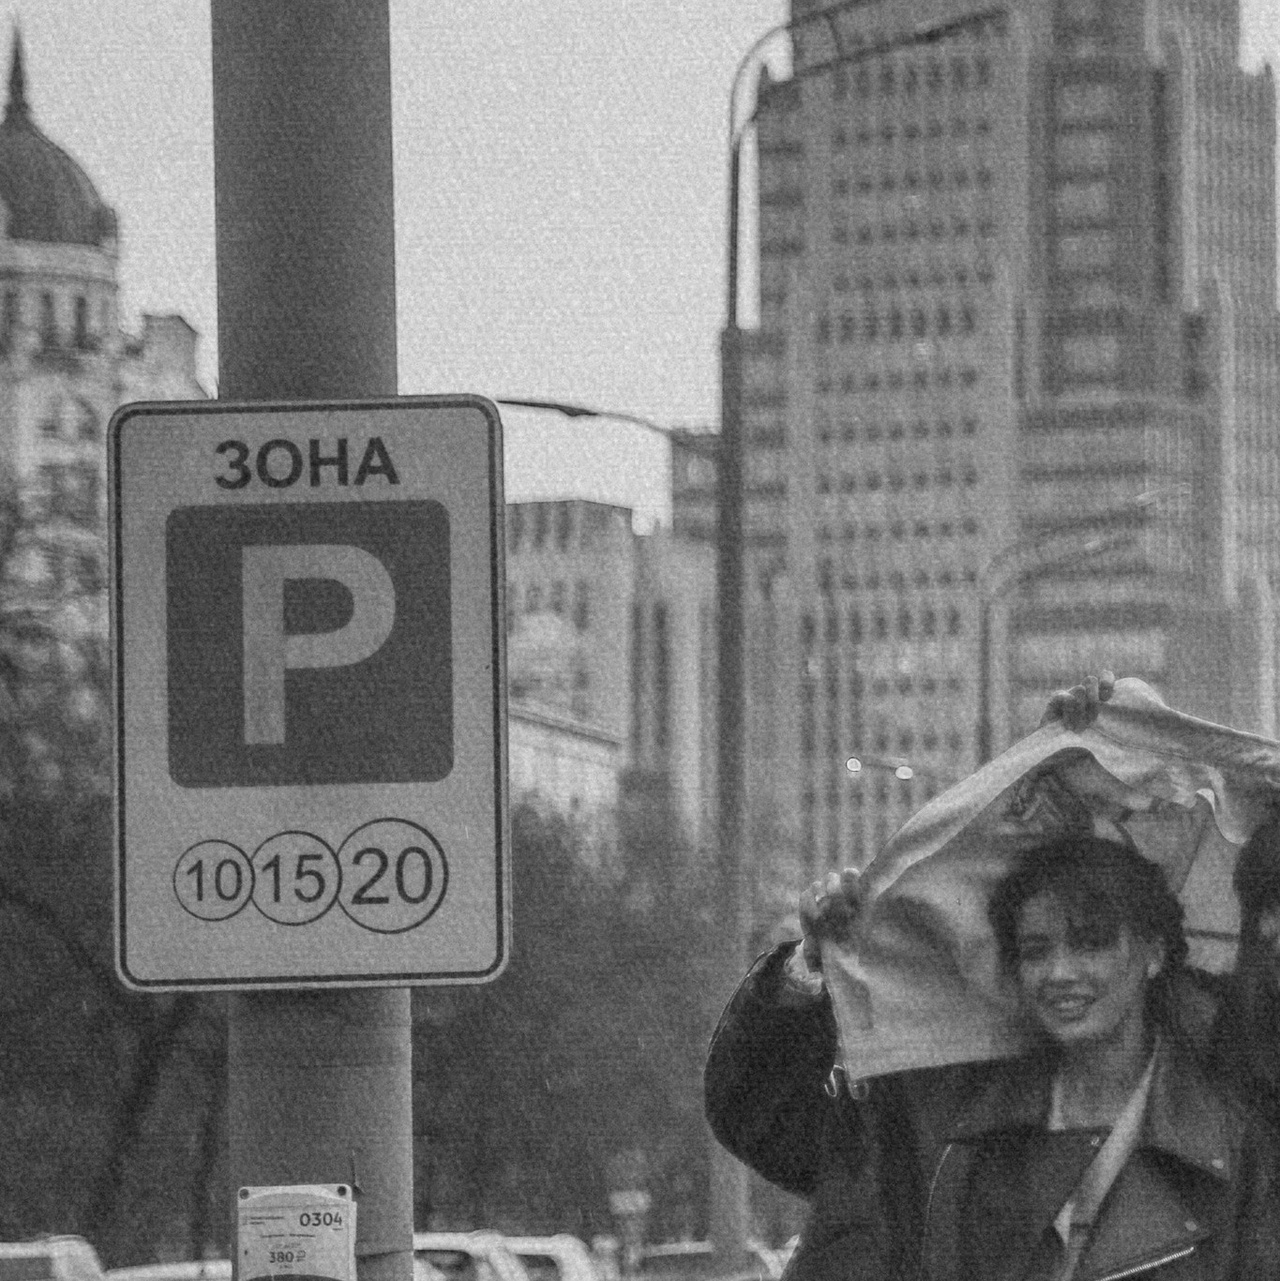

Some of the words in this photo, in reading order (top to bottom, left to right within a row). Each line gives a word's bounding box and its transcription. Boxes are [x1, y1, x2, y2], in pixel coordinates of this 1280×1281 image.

[214, 436, 400, 490] ЗОНА
[242, 544, 396, 745] P
[186, 858, 243, 902] 10
[261, 853, 326, 904] 15
[351, 846, 434, 905] 20
[299, 1212, 342, 1226] 0304
[269, 1251, 294, 1263] 380
